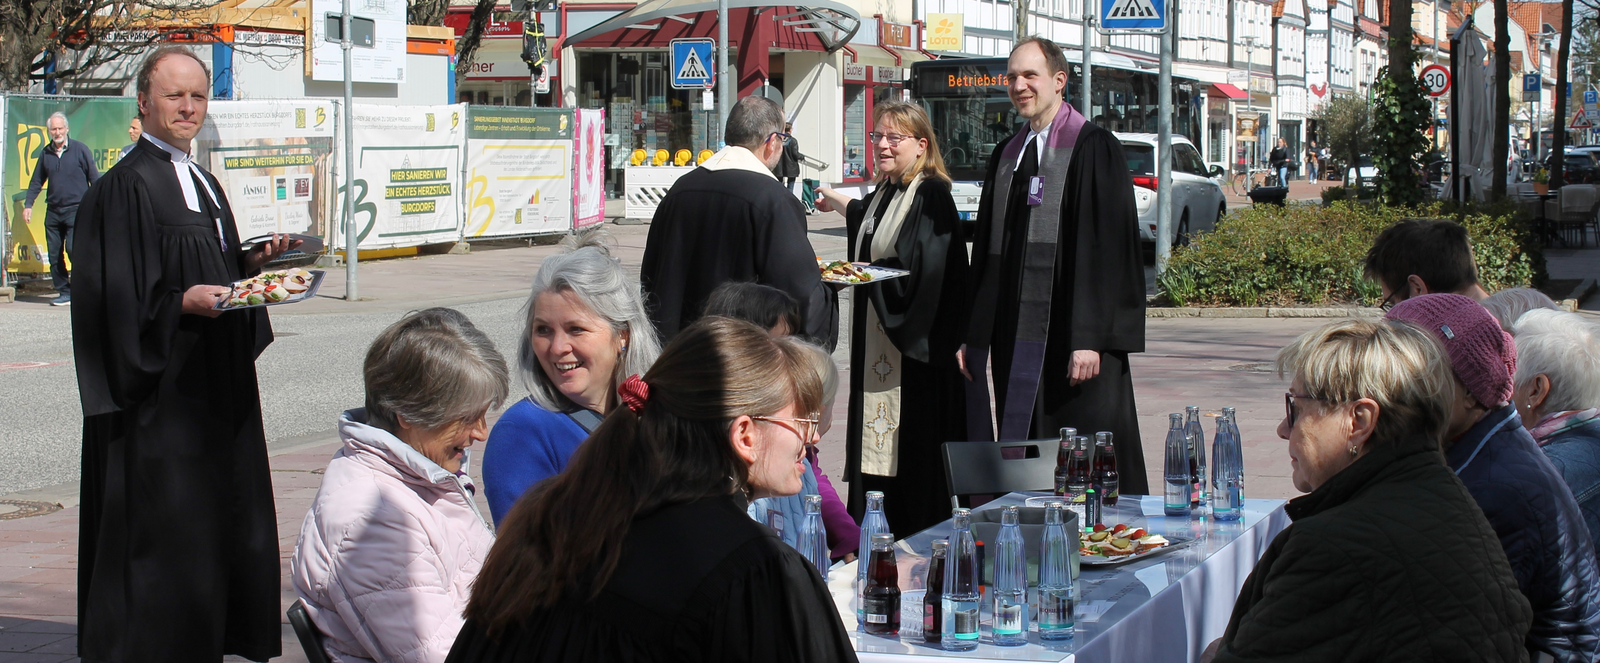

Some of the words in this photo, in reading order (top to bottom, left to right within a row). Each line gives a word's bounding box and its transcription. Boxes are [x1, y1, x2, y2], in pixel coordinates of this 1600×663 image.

[929, 37, 958, 45] LOTTO
[948, 74, 1009, 87] Betriebsfa
[1426, 73, 1445, 88] 30
[1526, 76, 1537, 89] P
[1587, 93, 1595, 102] P
[93, 148, 122, 170] RFE
[225, 158, 239, 168] WIR
[239, 157, 254, 167] SIND
[255, 156, 285, 166] WEITERHIN
[285, 154, 296, 165] FÜR
[296, 155, 304, 164] SIE
[304, 155, 313, 163] DA
[391, 170, 405, 180] HIER
[405, 169, 433, 180] SANIEREN
[434, 169, 446, 178] WIR
[295, 179, 309, 189] FEY
[386, 187, 395, 198] EIN
[395, 186, 417, 197] ECHTES
[417, 183, 450, 196] HERZSTÜCK
[401, 201, 435, 213] BURGDORFS
